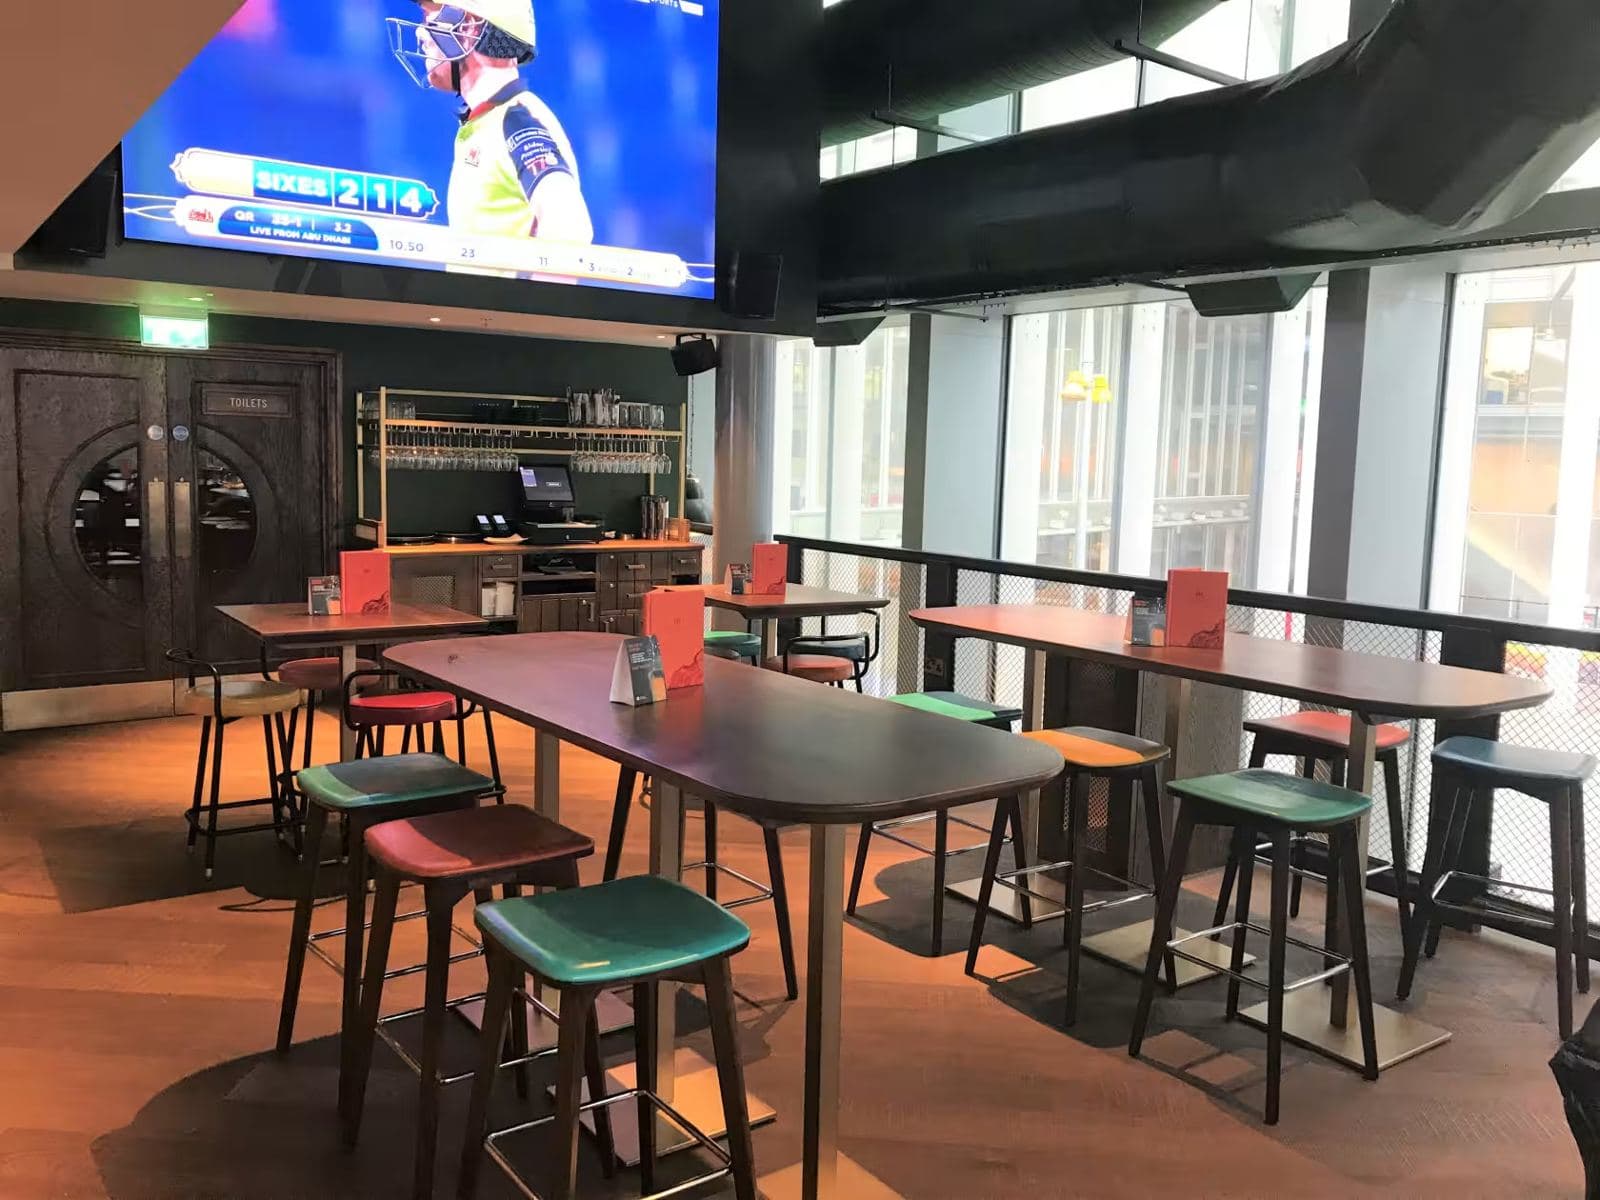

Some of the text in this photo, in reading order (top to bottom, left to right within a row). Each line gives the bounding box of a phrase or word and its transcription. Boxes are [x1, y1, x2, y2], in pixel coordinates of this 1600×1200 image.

[256, 171, 328, 197] SIXES
[250, 226, 351, 244] LIVE FROM ABU DHABI
[389, 239, 424, 253] 10.50
[460, 247, 476, 259] 23
[229, 397, 268, 409] TOILETS
